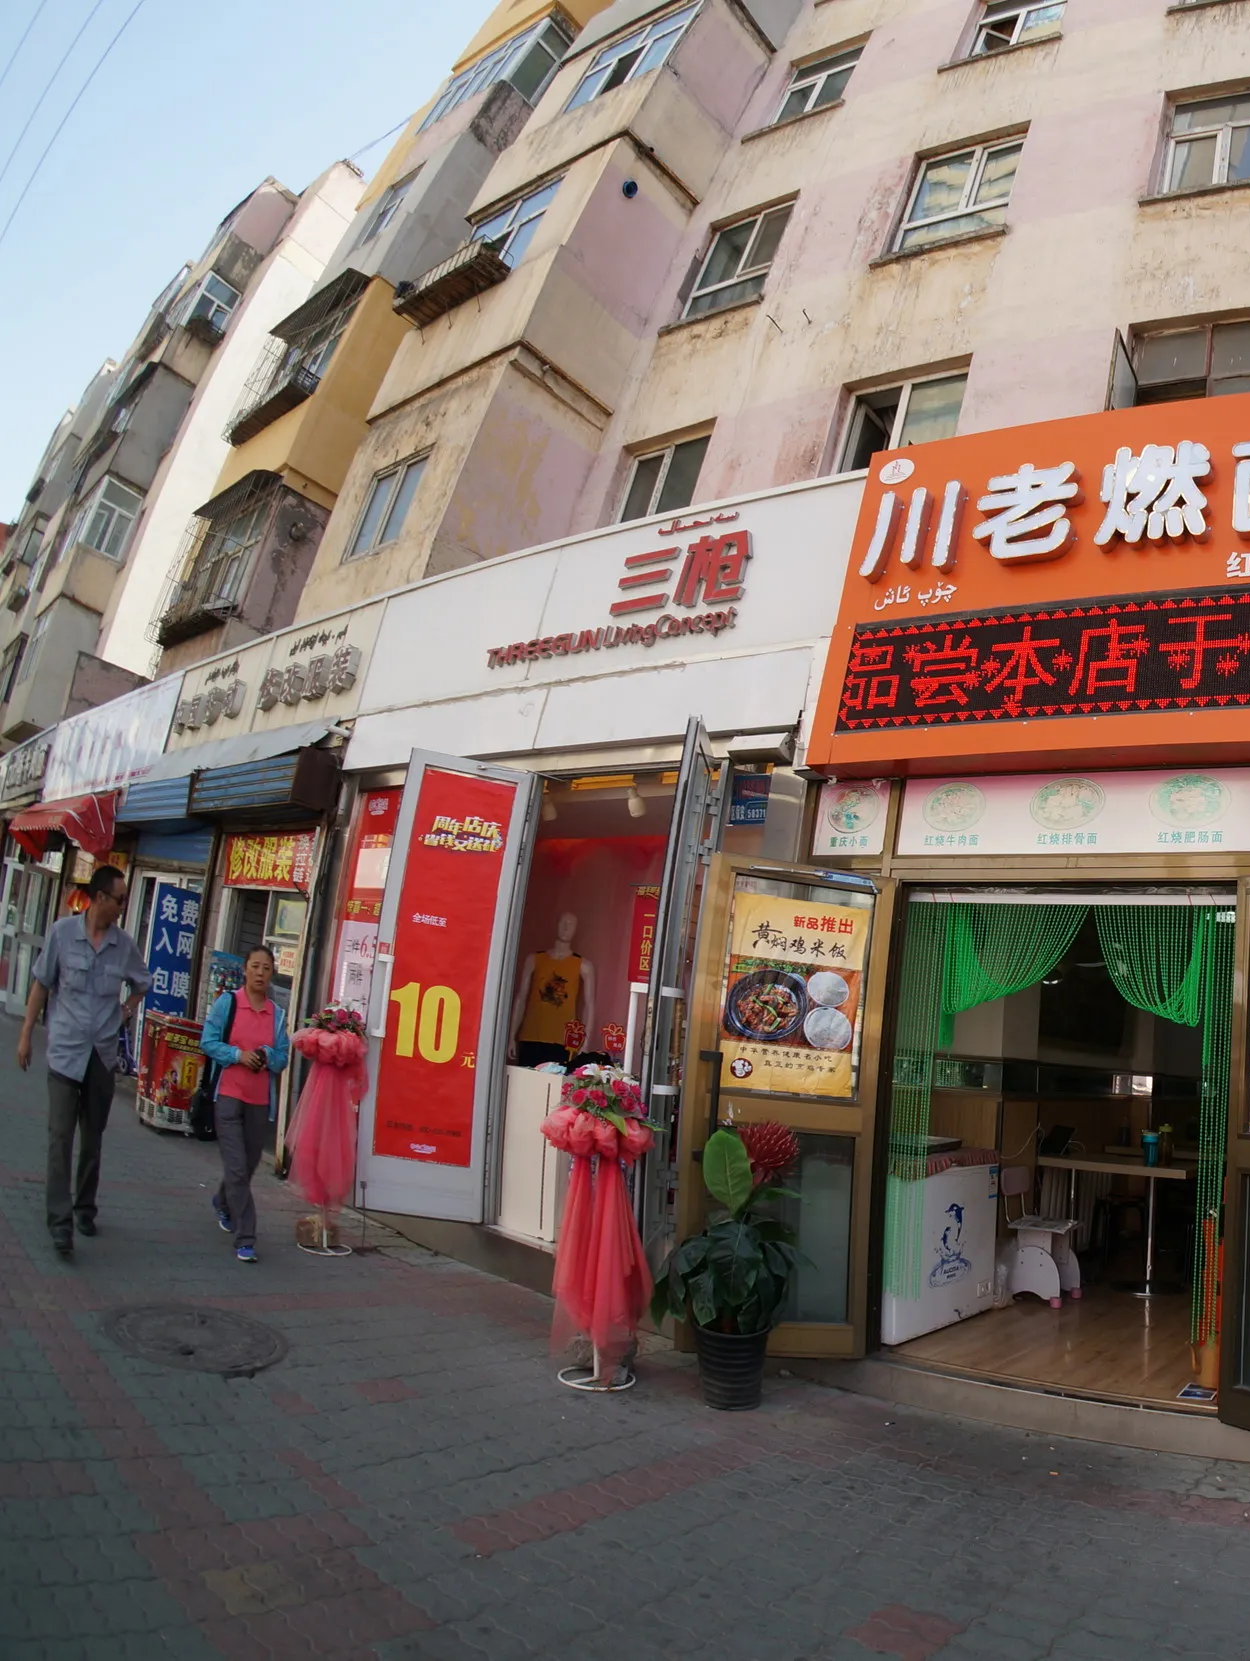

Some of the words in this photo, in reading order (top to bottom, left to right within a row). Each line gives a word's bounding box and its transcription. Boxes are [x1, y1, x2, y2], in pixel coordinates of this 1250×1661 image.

[609, 529, 753, 617] 三枪
[487, 626, 602, 670] THREEGUN
[431, 815, 502, 837] 周年店庆
[829, 835, 869, 848] 重庆小面
[924, 834, 979, 847] 红烧牛肉面
[1037, 832, 1098, 845] 红烧排骨面
[1157, 830, 1224, 844] 红烧肥肠面
[228, 836, 295, 882] 修改服装
[159, 894, 201, 927] 免费
[412, 912, 447, 928] 全场低至
[793, 915, 854, 935] 新品推出
[155, 927, 196, 960] 入网
[639, 913, 656, 971] 一口价区
[752, 920, 847, 960] 黄焖鸡米饭
[151, 966, 191, 999] 包膜
[390, 981, 461, 1064] 10
[460, 1051, 475, 1068] 元
